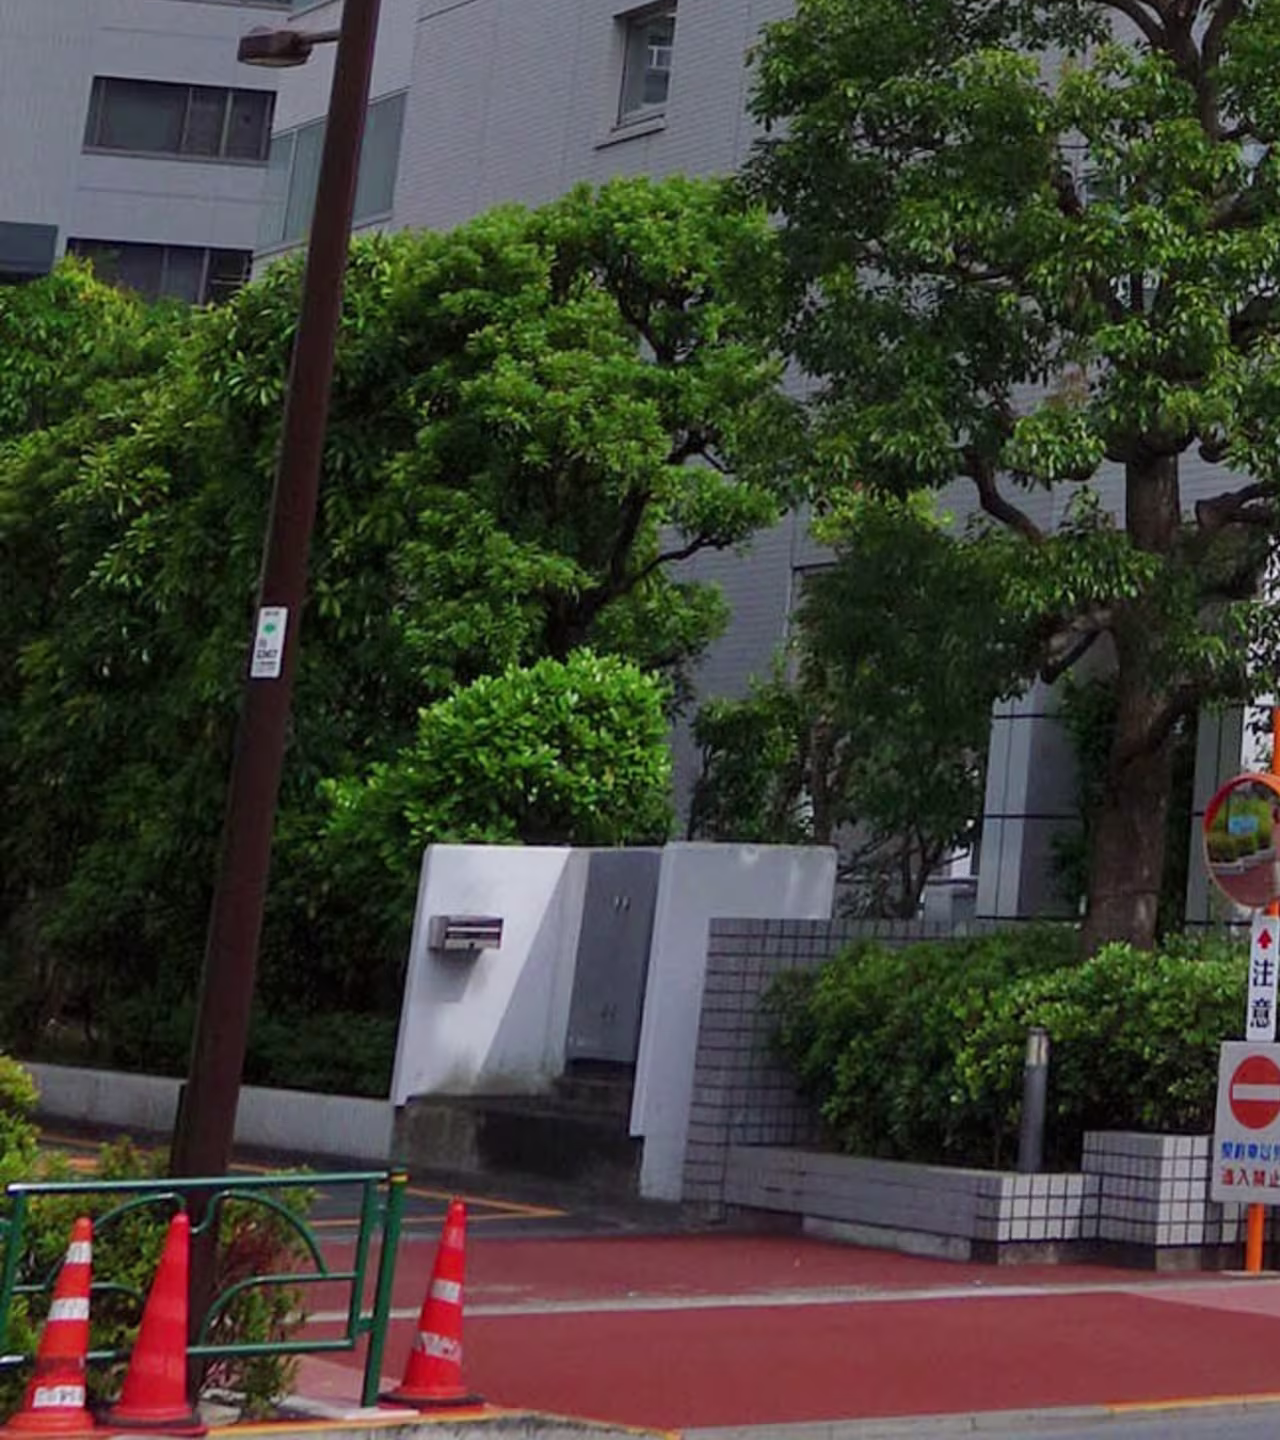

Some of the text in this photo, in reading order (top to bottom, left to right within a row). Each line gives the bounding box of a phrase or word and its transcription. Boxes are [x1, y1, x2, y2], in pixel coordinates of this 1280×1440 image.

[1249, 959, 1274, 1029] 注意
[1221, 1166, 1280, 1188] 進入禁止
